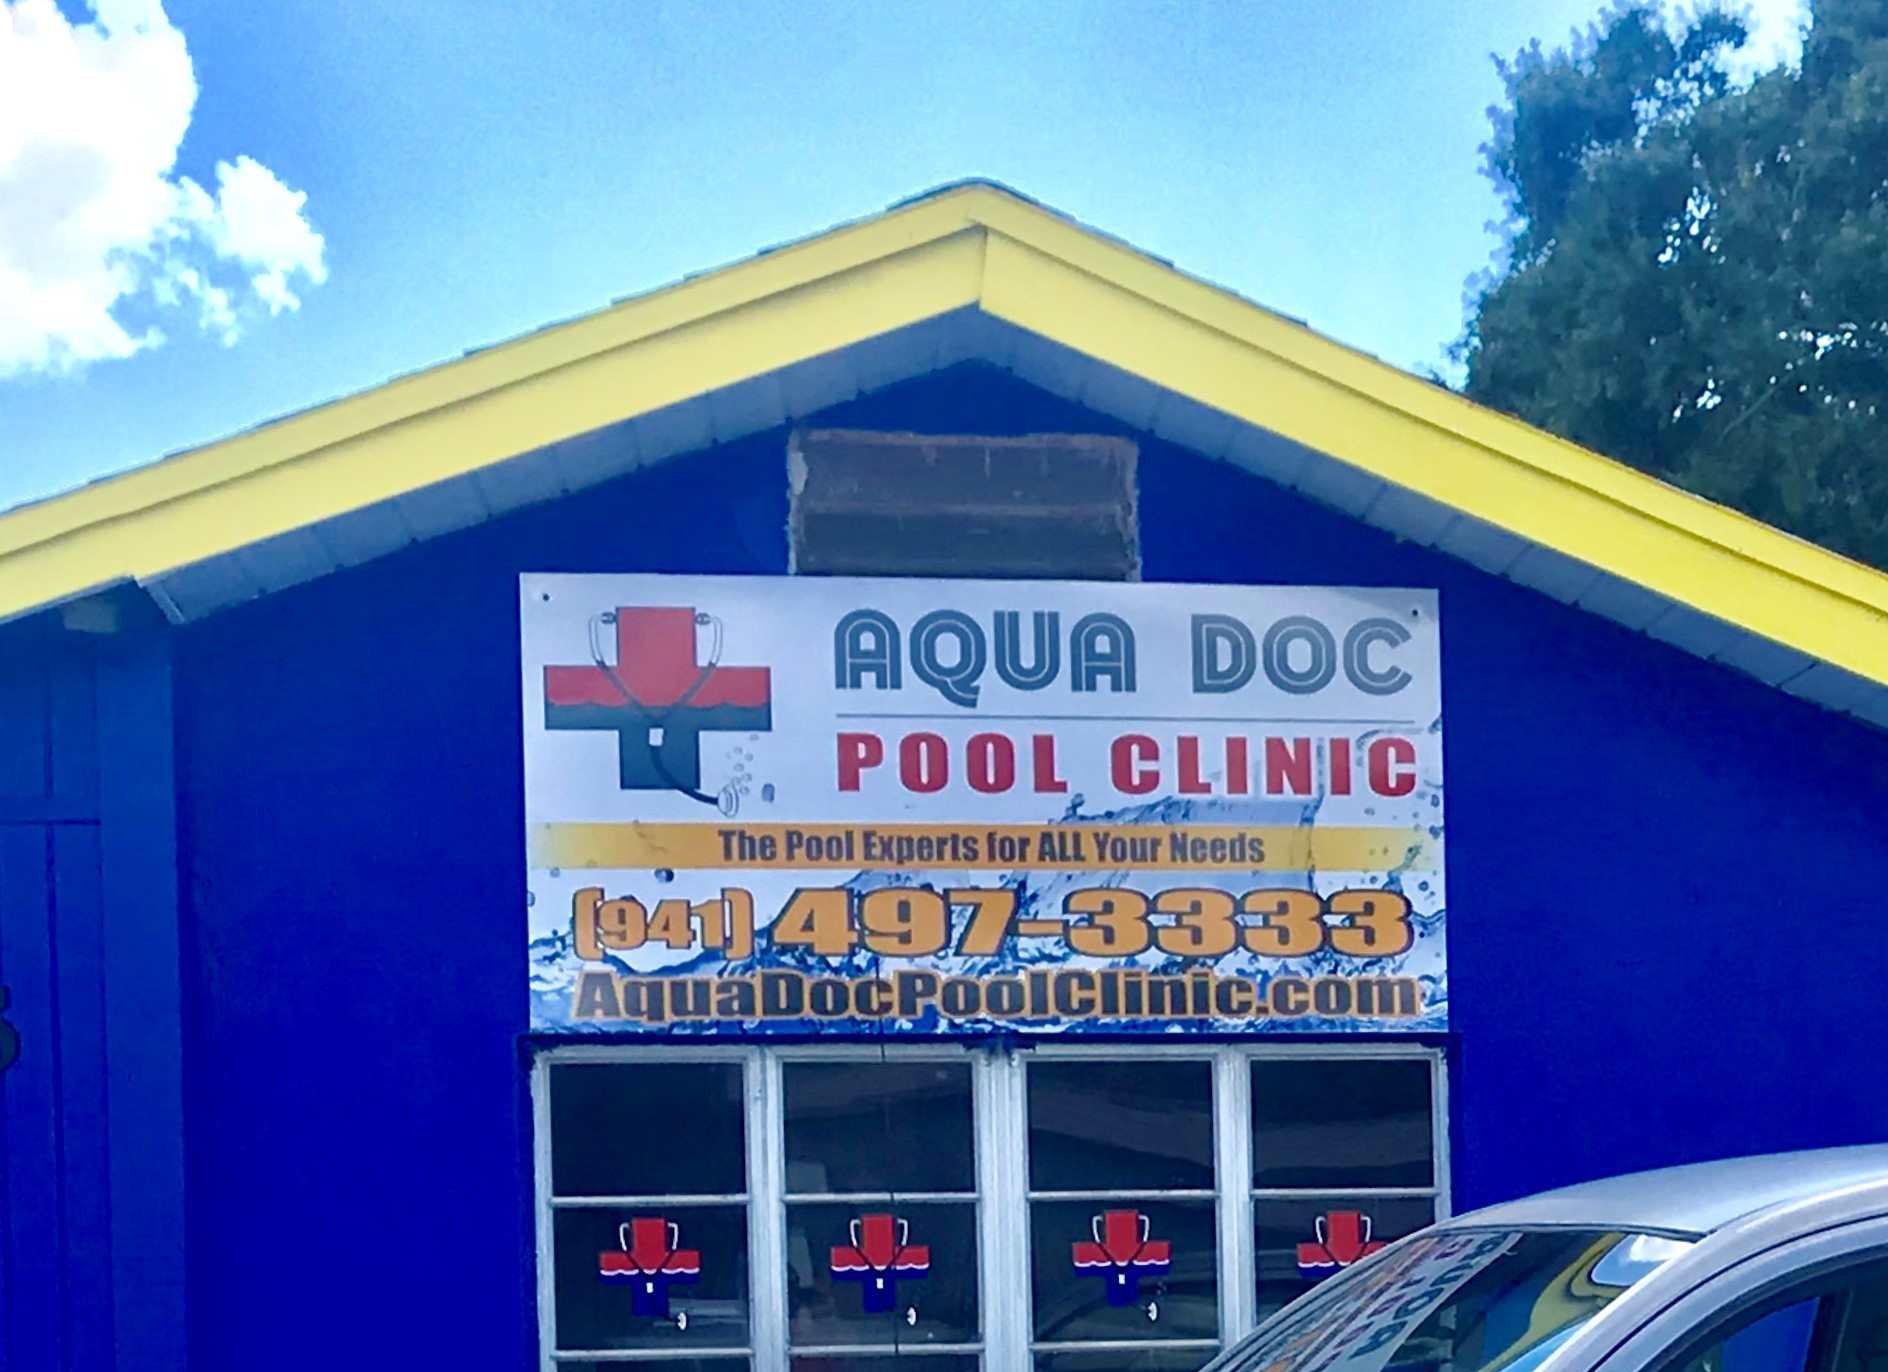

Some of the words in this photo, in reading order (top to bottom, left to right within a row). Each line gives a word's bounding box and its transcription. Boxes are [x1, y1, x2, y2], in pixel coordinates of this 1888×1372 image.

[834, 609, 1137, 708] AQUA
[1191, 614, 1413, 696] DOC
[836, 731, 1068, 794] POOL
[1110, 735, 1418, 798] CLINIC
[719, 830, 776, 861] The
[786, 830, 853, 861] Pool
[863, 830, 978, 865] Experts
[986, 831, 1030, 862] for
[1038, 832, 1085, 862] ALL
[1094, 832, 1161, 862] Your
[1169, 833, 1265, 863] Needs
[573, 886, 755, 960] (941)
[770, 886, 1414, 958] 497-3333
[574, 967, 1421, 1024] AquaDocPoolClinic.com
